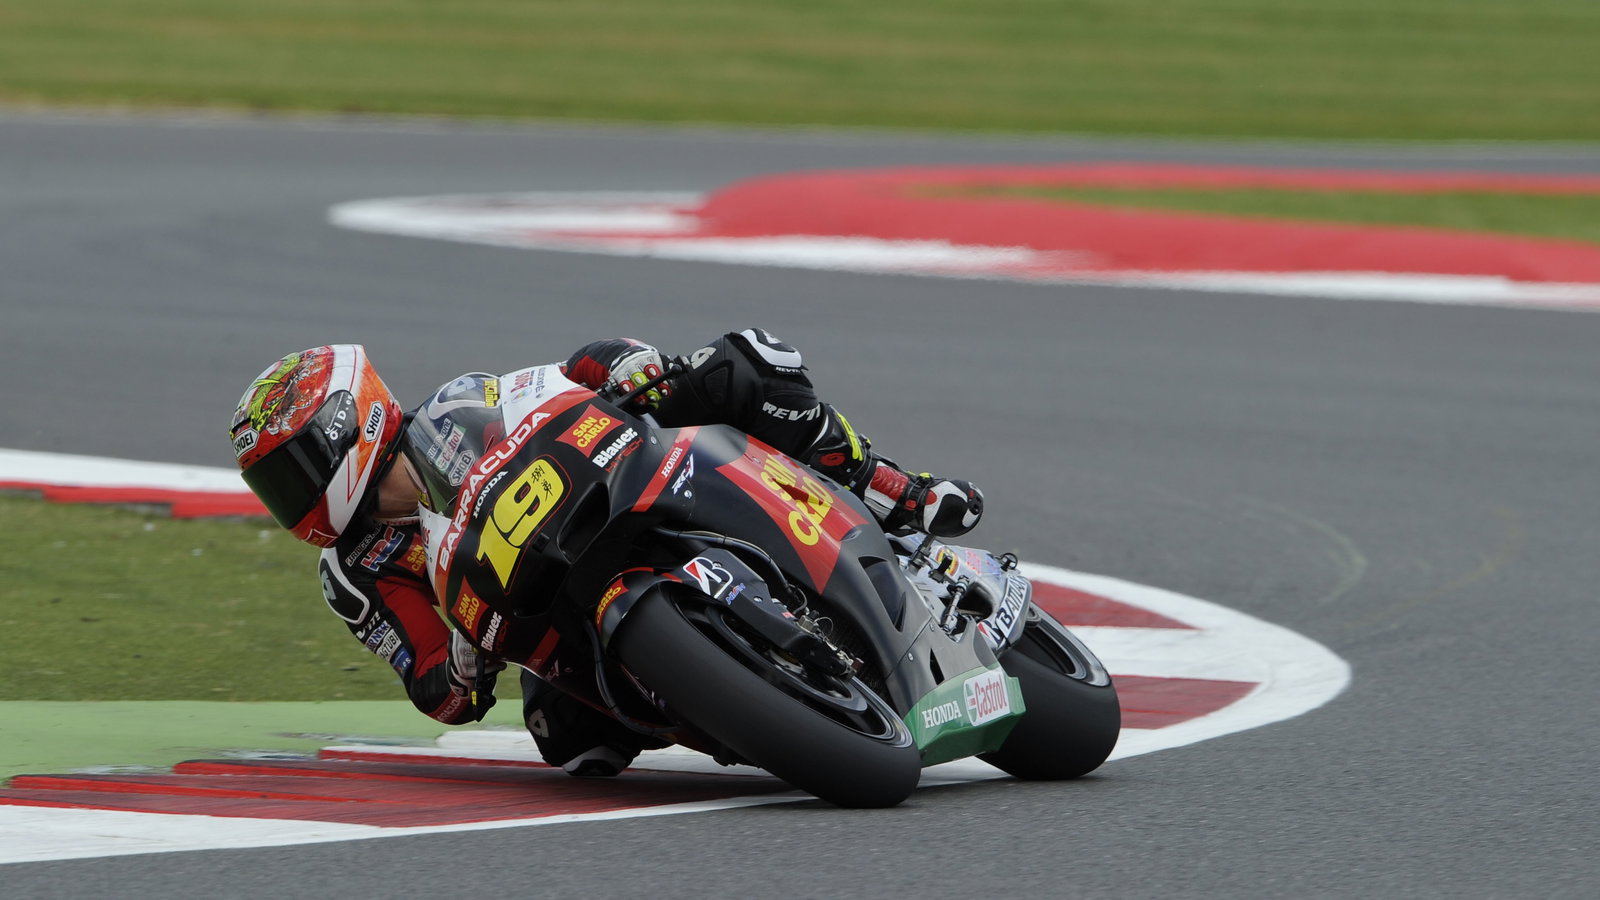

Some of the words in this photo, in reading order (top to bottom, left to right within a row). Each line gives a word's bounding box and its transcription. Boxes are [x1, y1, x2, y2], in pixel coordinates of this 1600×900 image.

[367, 404, 382, 437] SHOEI
[572, 416, 598, 437] SAN
[576, 416, 611, 448] CARLO
[234, 433, 254, 456] SHOEI
[442, 430, 461, 462] Castrol
[453, 454, 472, 482] SHOEI
[661, 446, 683, 478] HONDA
[438, 411, 551, 571] BARRACUDA
[473, 470, 509, 519] HONDA
[476, 458, 564, 589] 19
[360, 526, 405, 572] HRC
[407, 544, 424, 563] SAN
[411, 550, 426, 572] CAR
[458, 593, 471, 618] SAN
[464, 597, 480, 631] CARLO
[921, 700, 963, 729] HONDA
[974, 679, 1006, 718] Castrol
